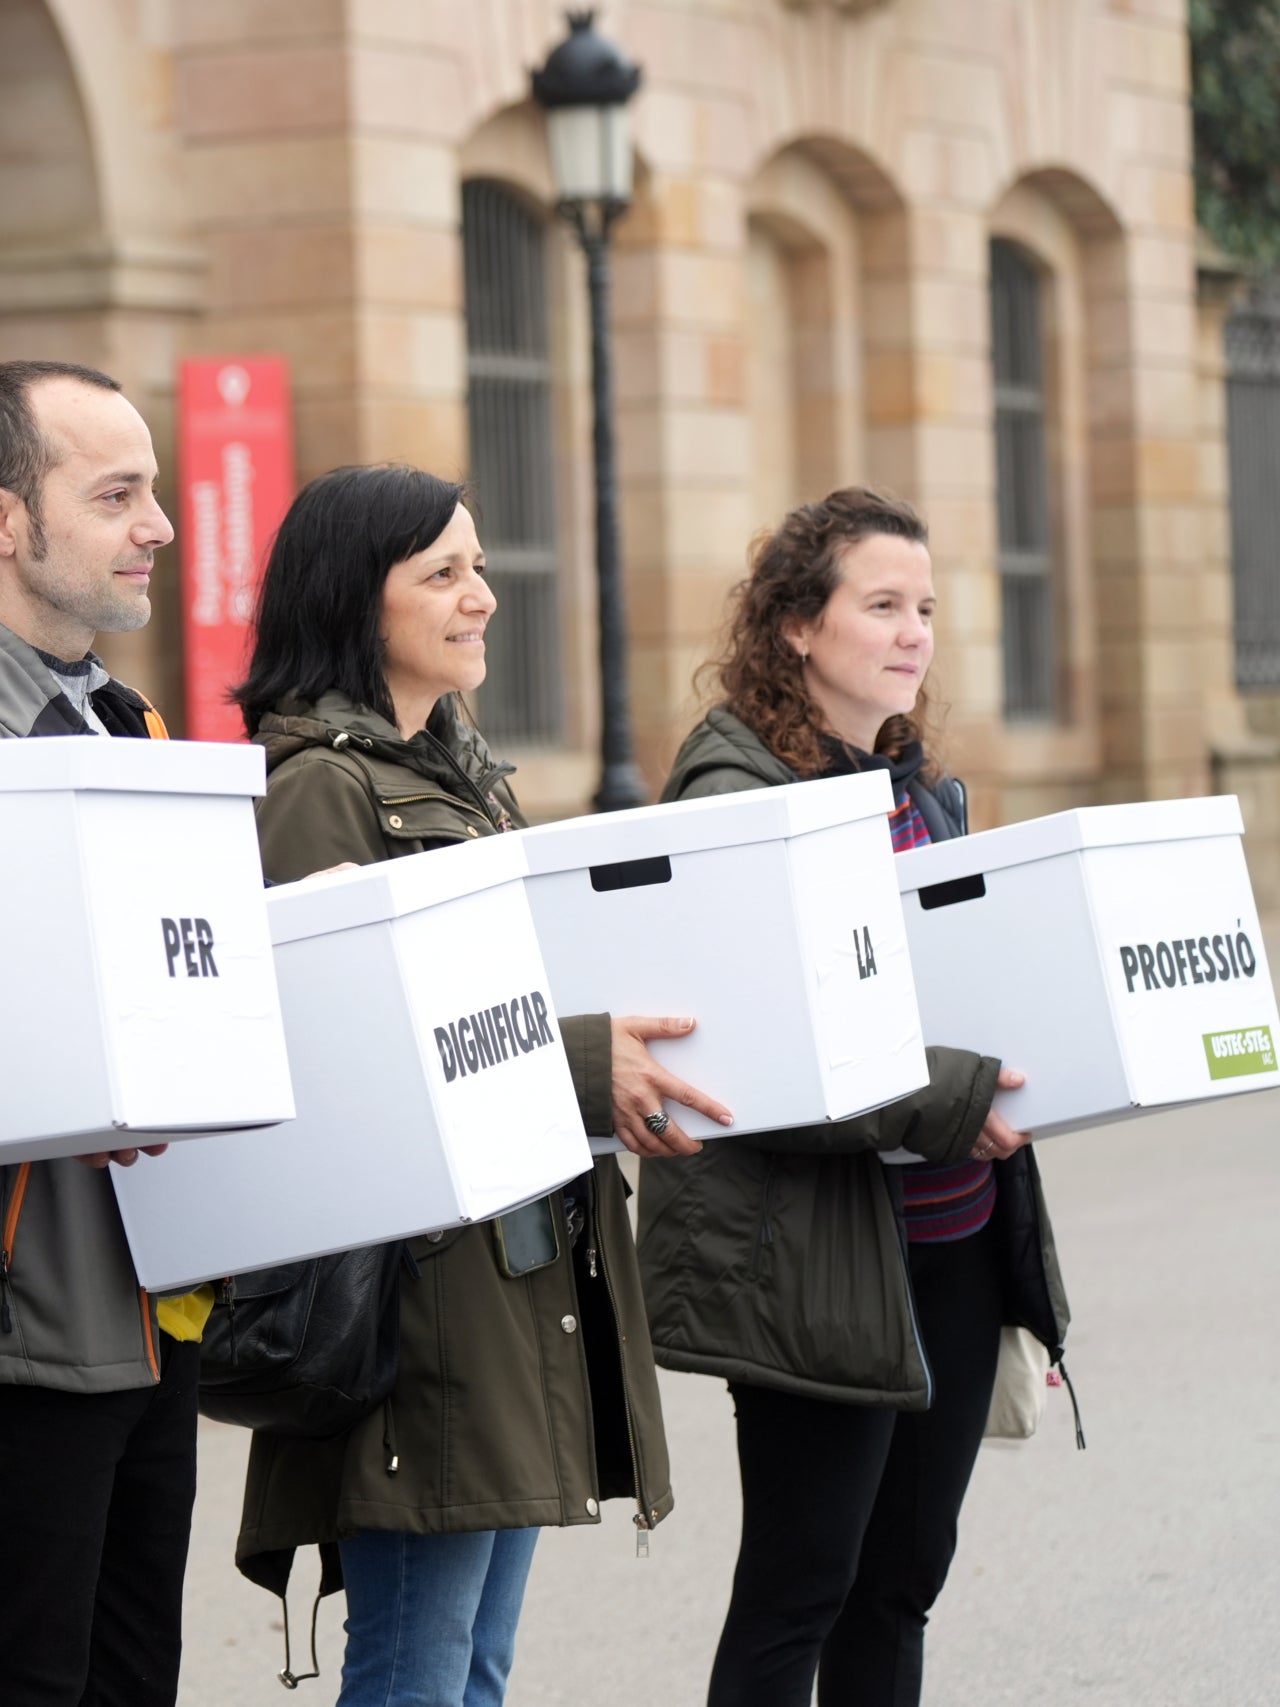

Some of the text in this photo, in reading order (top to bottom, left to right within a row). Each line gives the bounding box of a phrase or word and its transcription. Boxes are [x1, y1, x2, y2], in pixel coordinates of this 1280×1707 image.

[161, 918, 219, 978] PER
[853, 925, 878, 980] LA
[1120, 918, 1256, 993] PROFESSIÓ
[433, 990, 554, 1084] DIGNIFICAR
